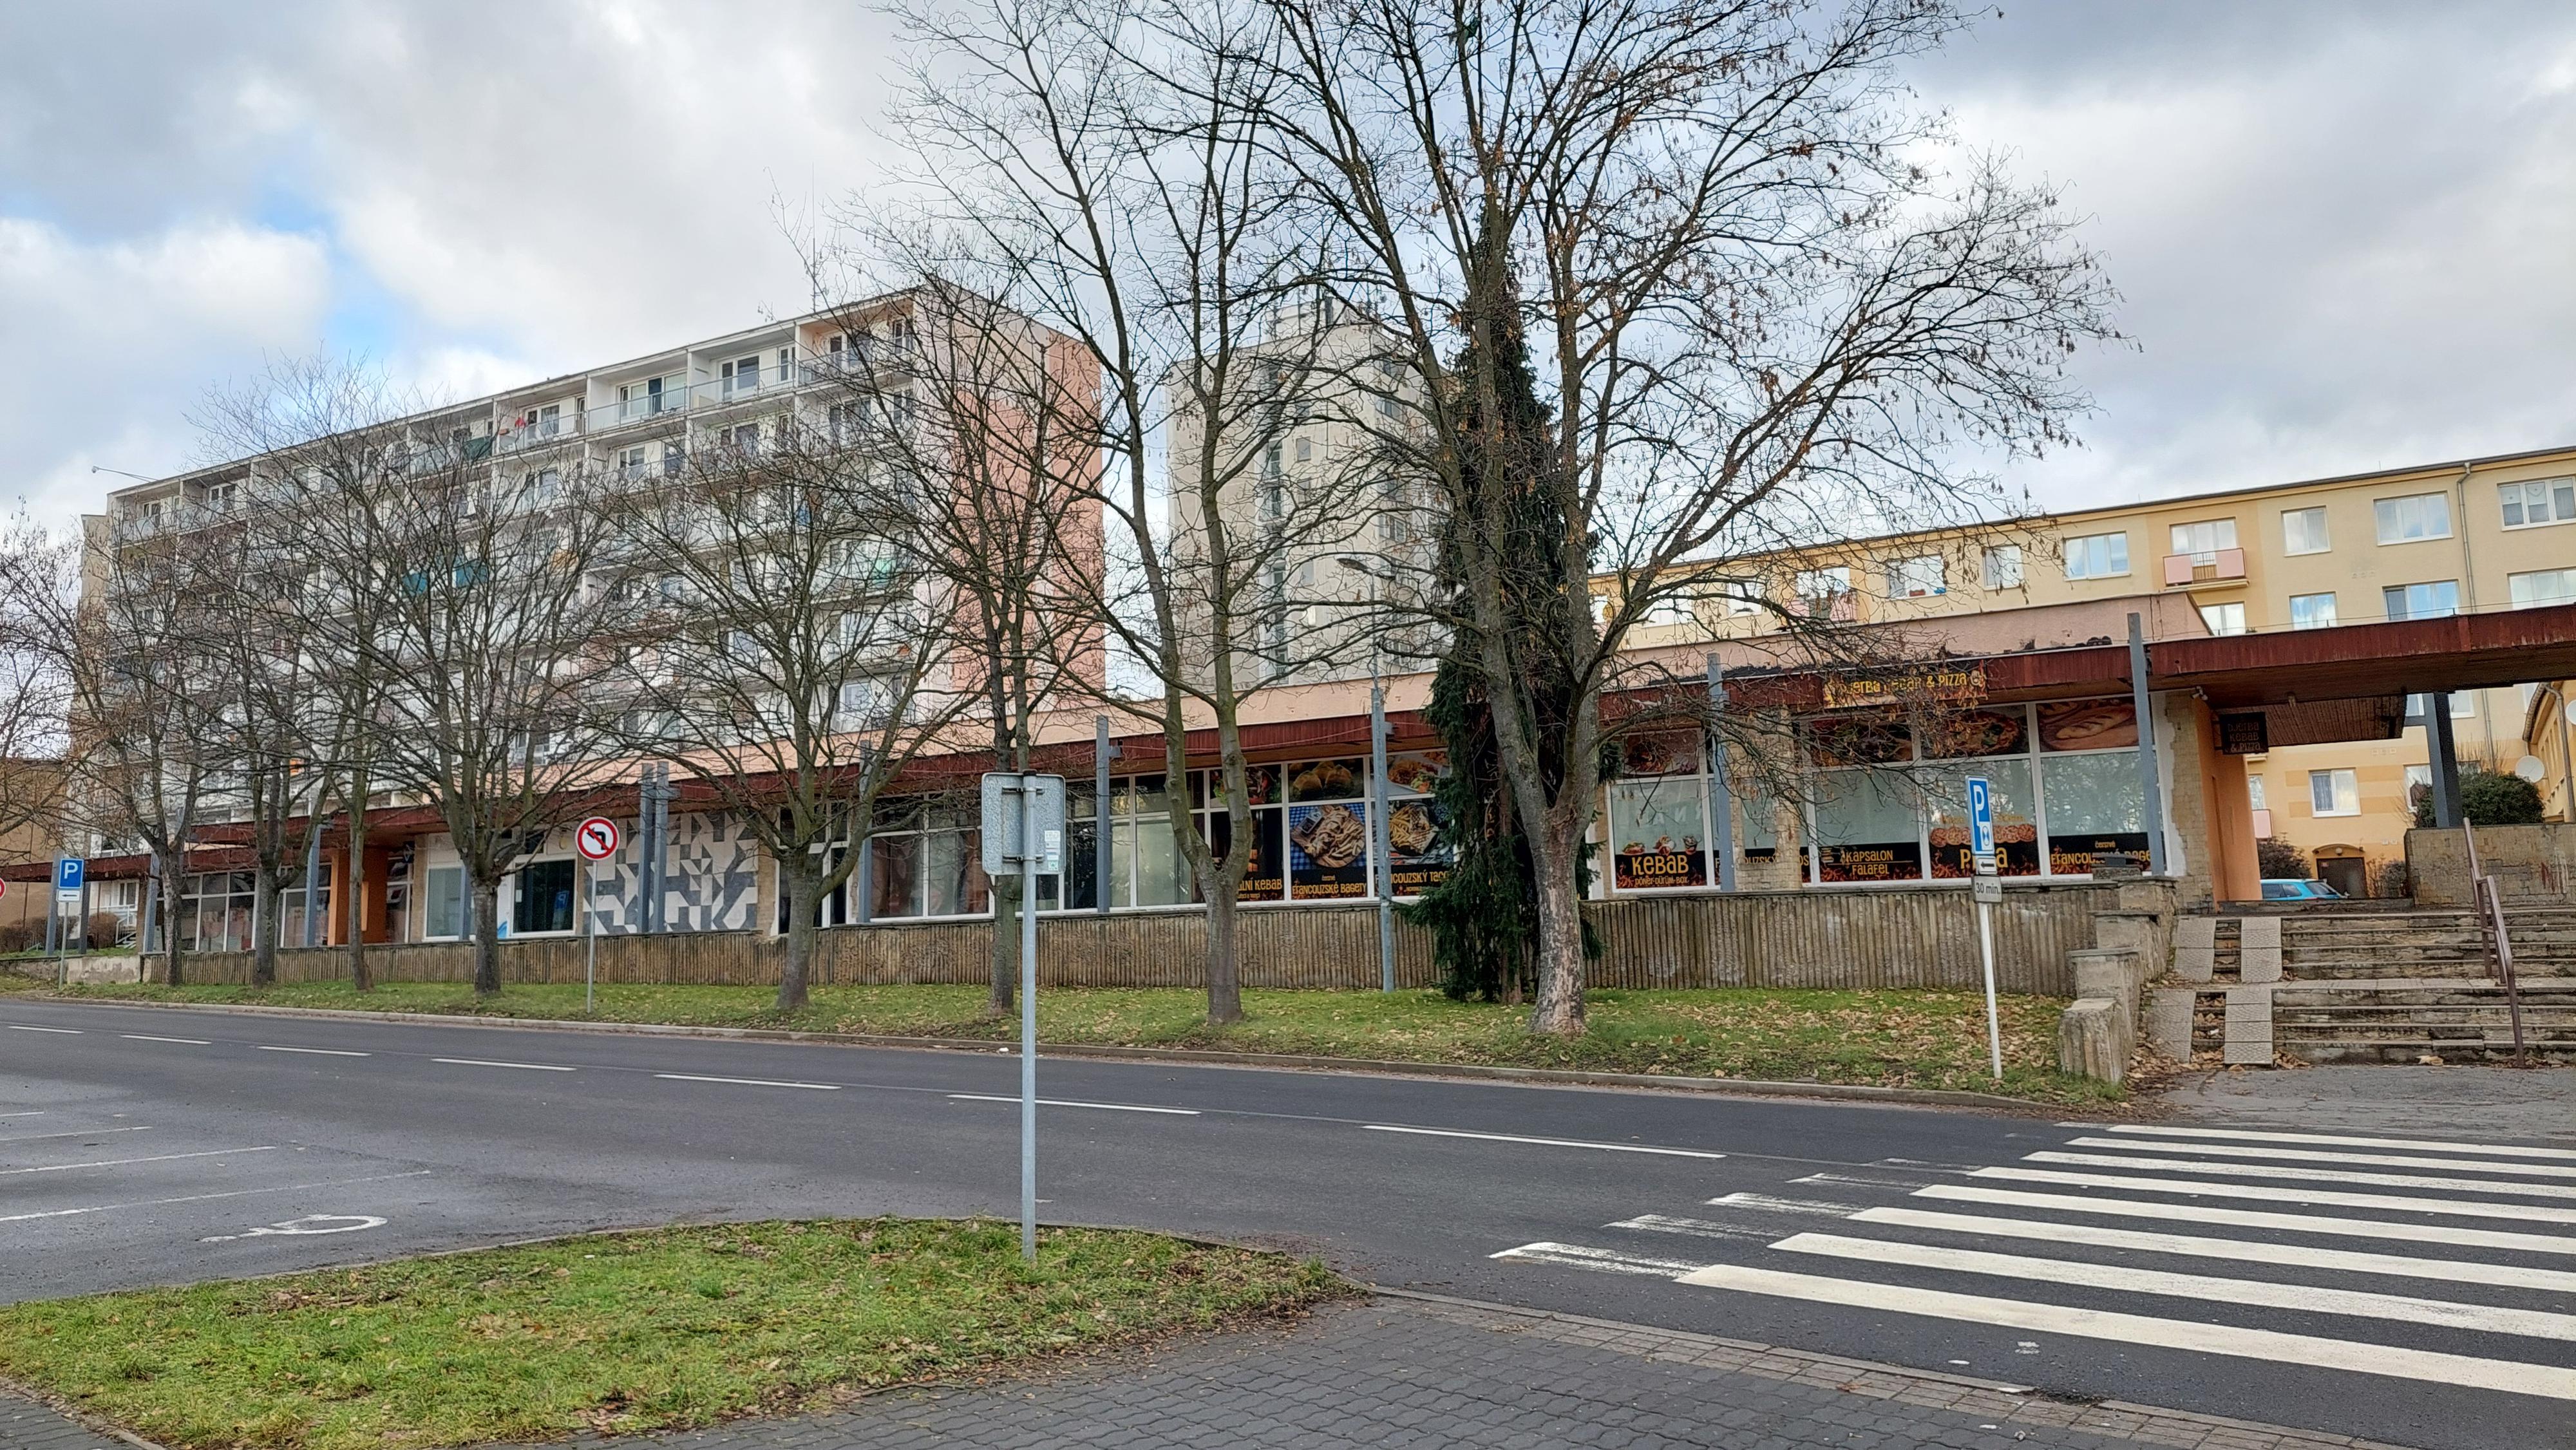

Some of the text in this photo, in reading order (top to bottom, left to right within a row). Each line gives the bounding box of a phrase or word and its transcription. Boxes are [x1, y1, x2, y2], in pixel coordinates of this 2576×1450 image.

[1926, 675, 1935, 688] &
[1973, 785, 1985, 827] P
[64, 862, 78, 879] P
[1976, 883, 2000, 894] 30 min.
